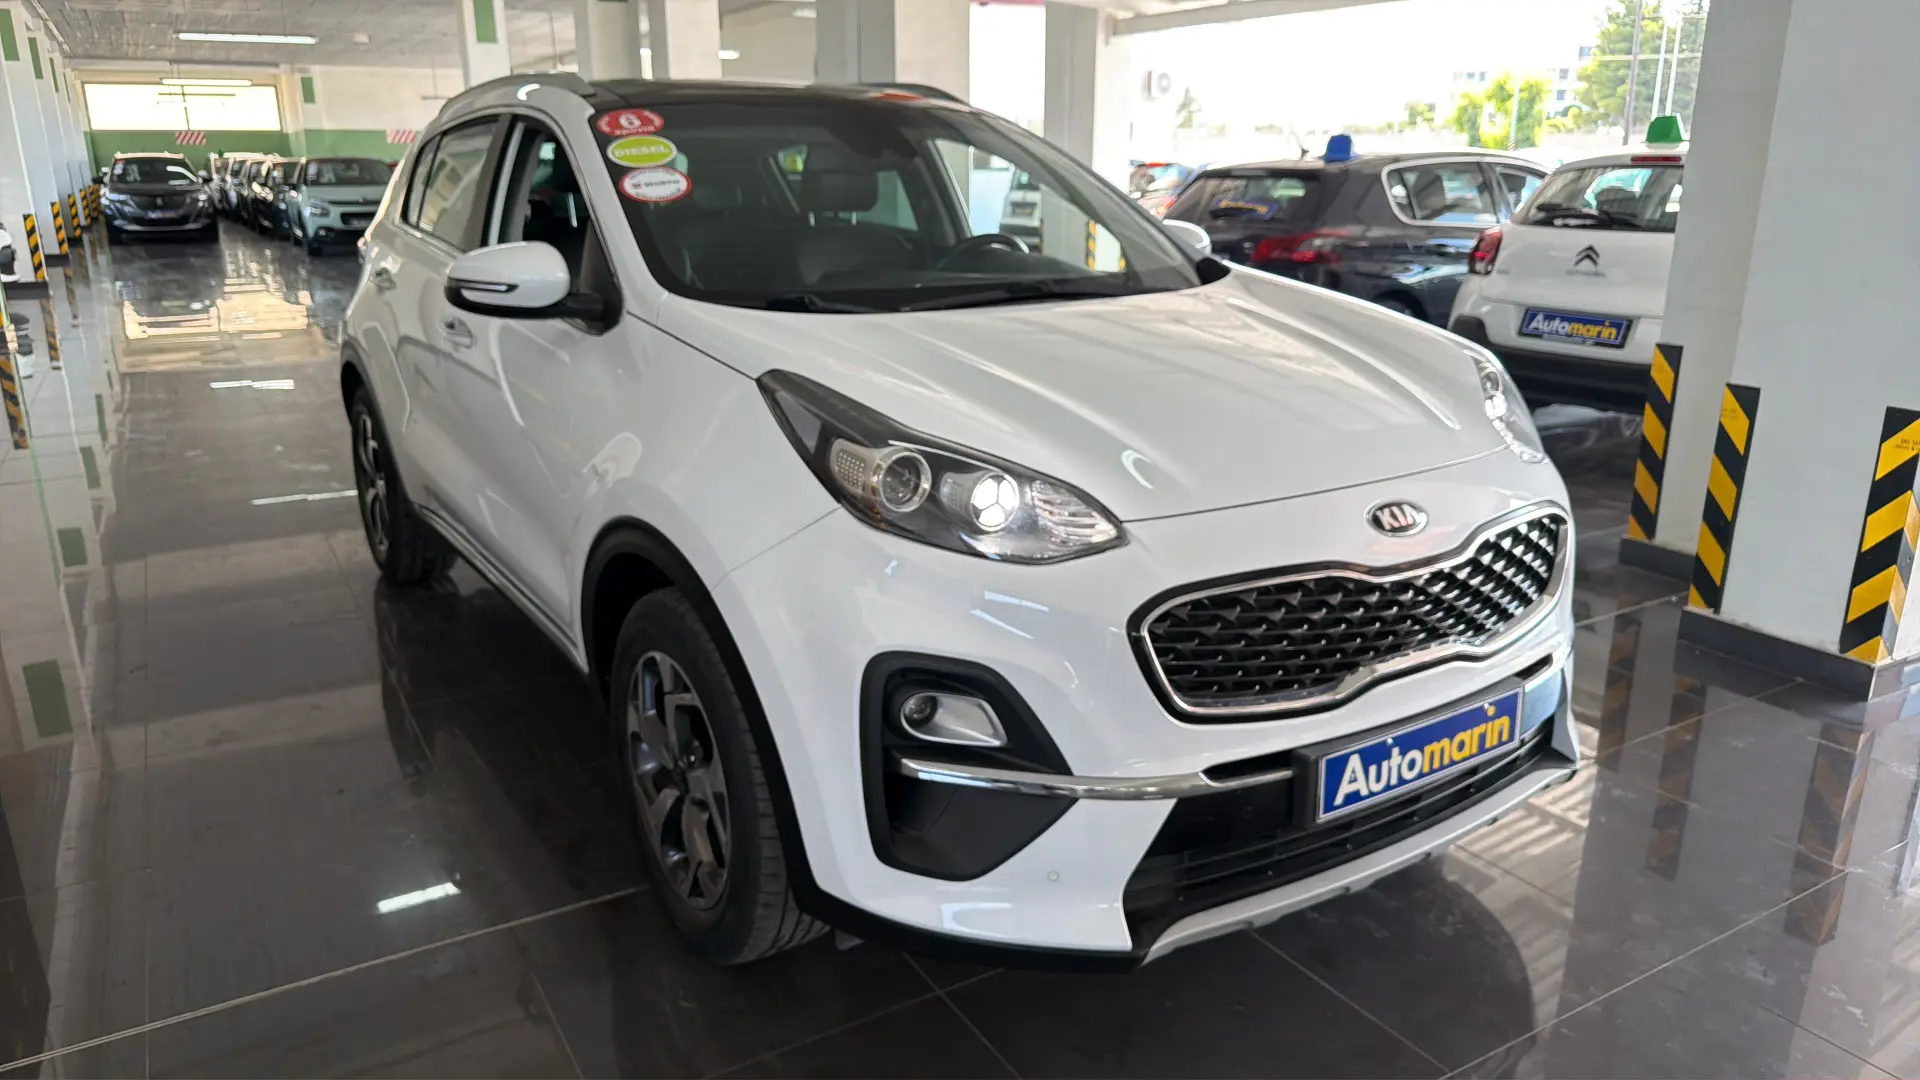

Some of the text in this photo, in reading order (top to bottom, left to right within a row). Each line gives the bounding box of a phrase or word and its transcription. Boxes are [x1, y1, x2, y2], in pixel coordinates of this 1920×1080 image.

[614, 145, 667, 157] DIESEL
[1528, 312, 1617, 340] Automarin
[1375, 503, 1421, 531] KIA
[1333, 706, 1510, 806] Automarin
